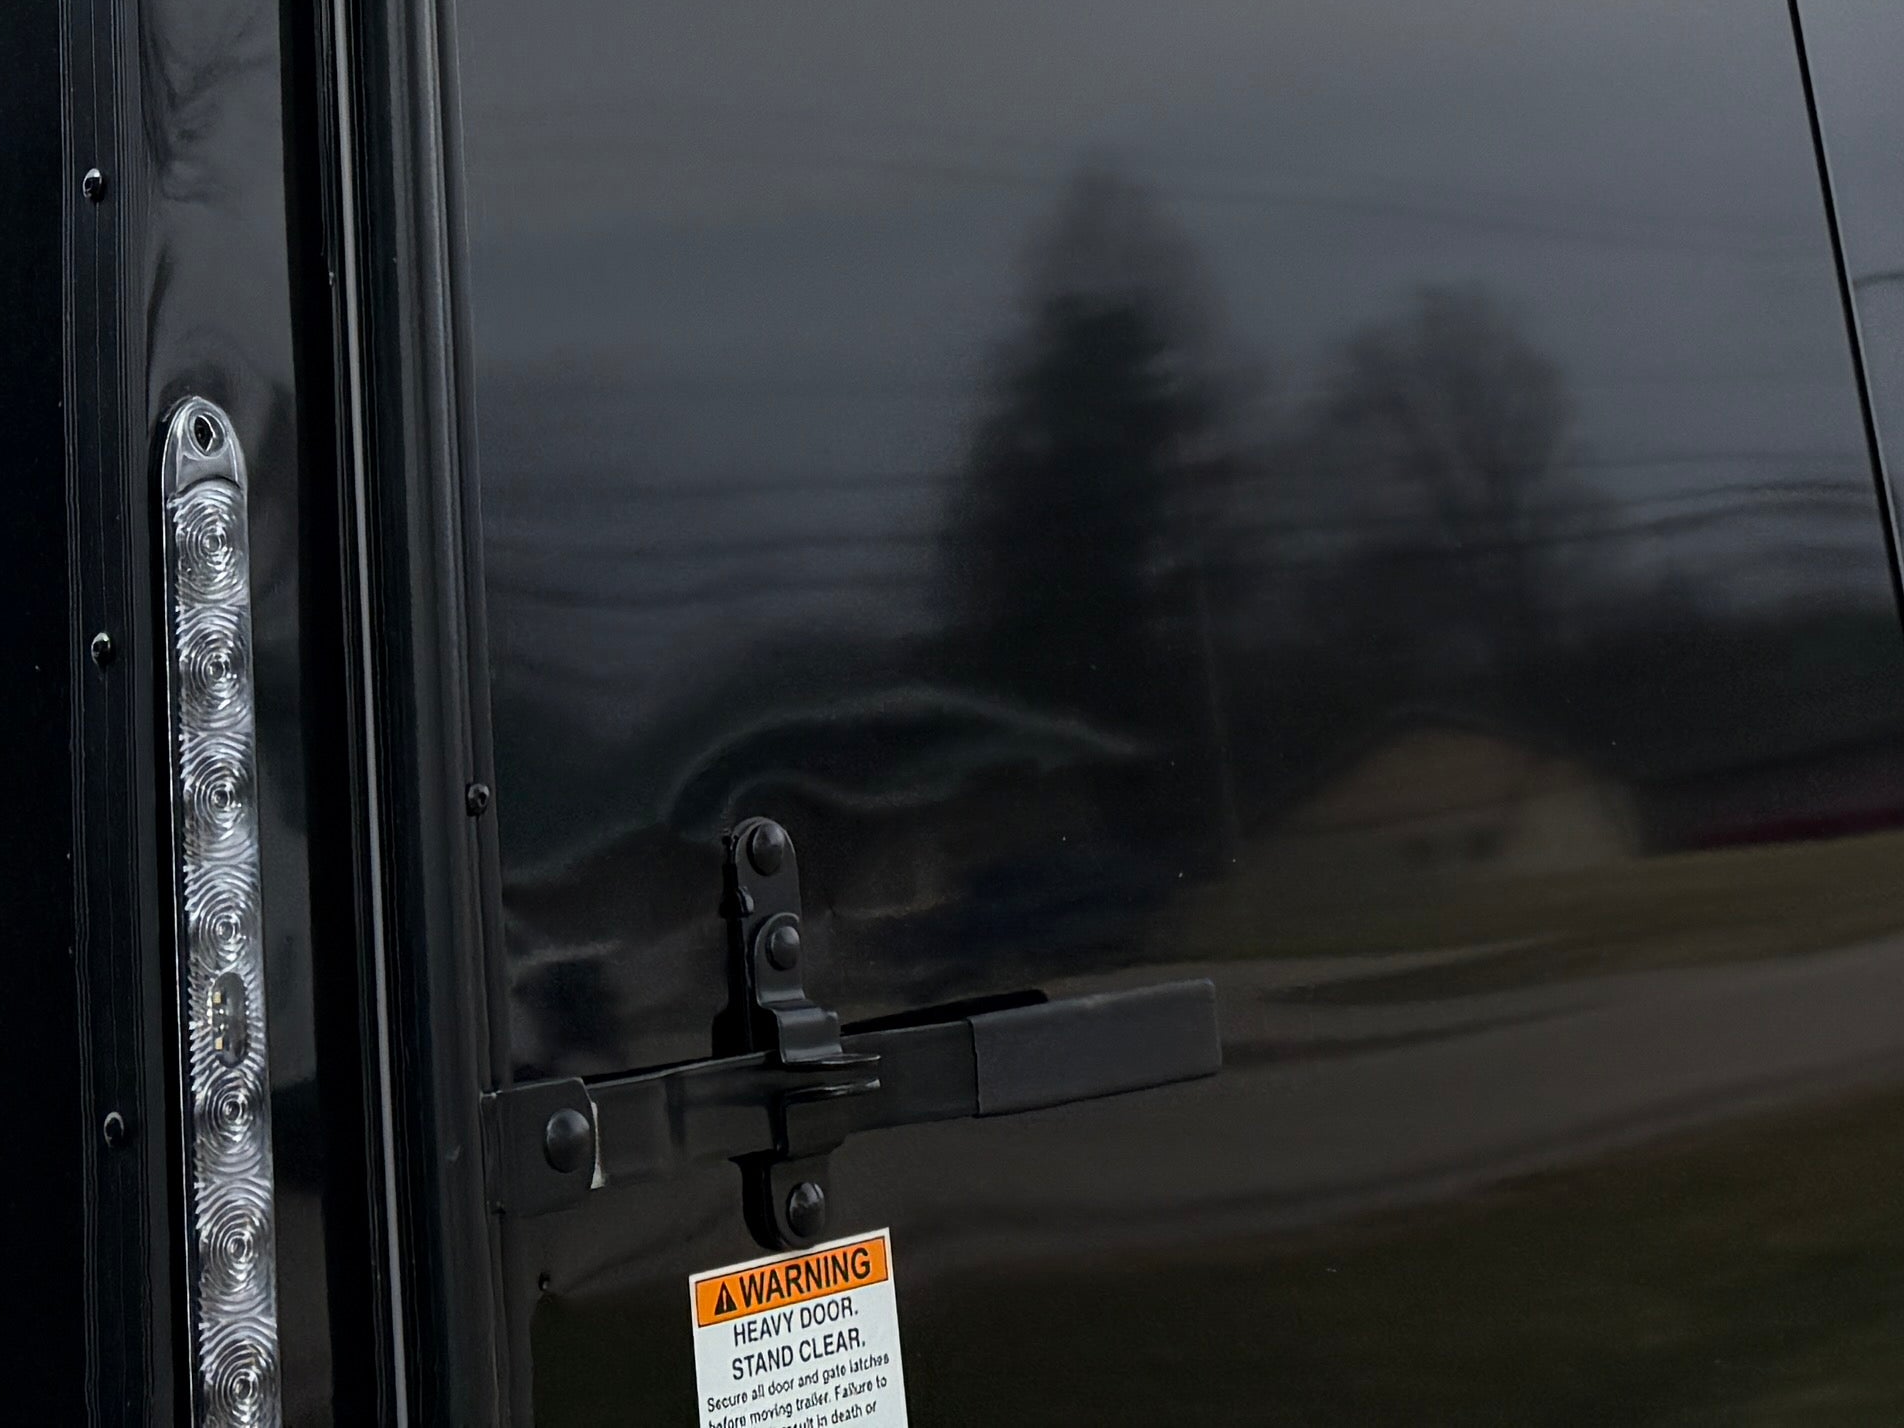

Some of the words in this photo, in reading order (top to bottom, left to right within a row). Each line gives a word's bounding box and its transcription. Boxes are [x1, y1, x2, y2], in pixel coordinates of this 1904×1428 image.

[739, 1247, 871, 1308] WARNING
[733, 1309, 794, 1347] HEAVY
[799, 1296, 859, 1329] DOOR.
[731, 1345, 794, 1381] STAND
[799, 1327, 866, 1363] CLEAR.
[707, 1391, 748, 1413] Secure
[751, 1383, 765, 1401] all
[768, 1378, 794, 1396] door
[798, 1369, 819, 1388] and
[822, 1363, 847, 1385] gate
[849, 1352, 890, 1374] latches
[749, 1402, 793, 1425] moving
[834, 1379, 873, 1401] Failure
[875, 1374, 888, 1389] to
[831, 1403, 863, 1425] death
[865, 1399, 877, 1416] or
